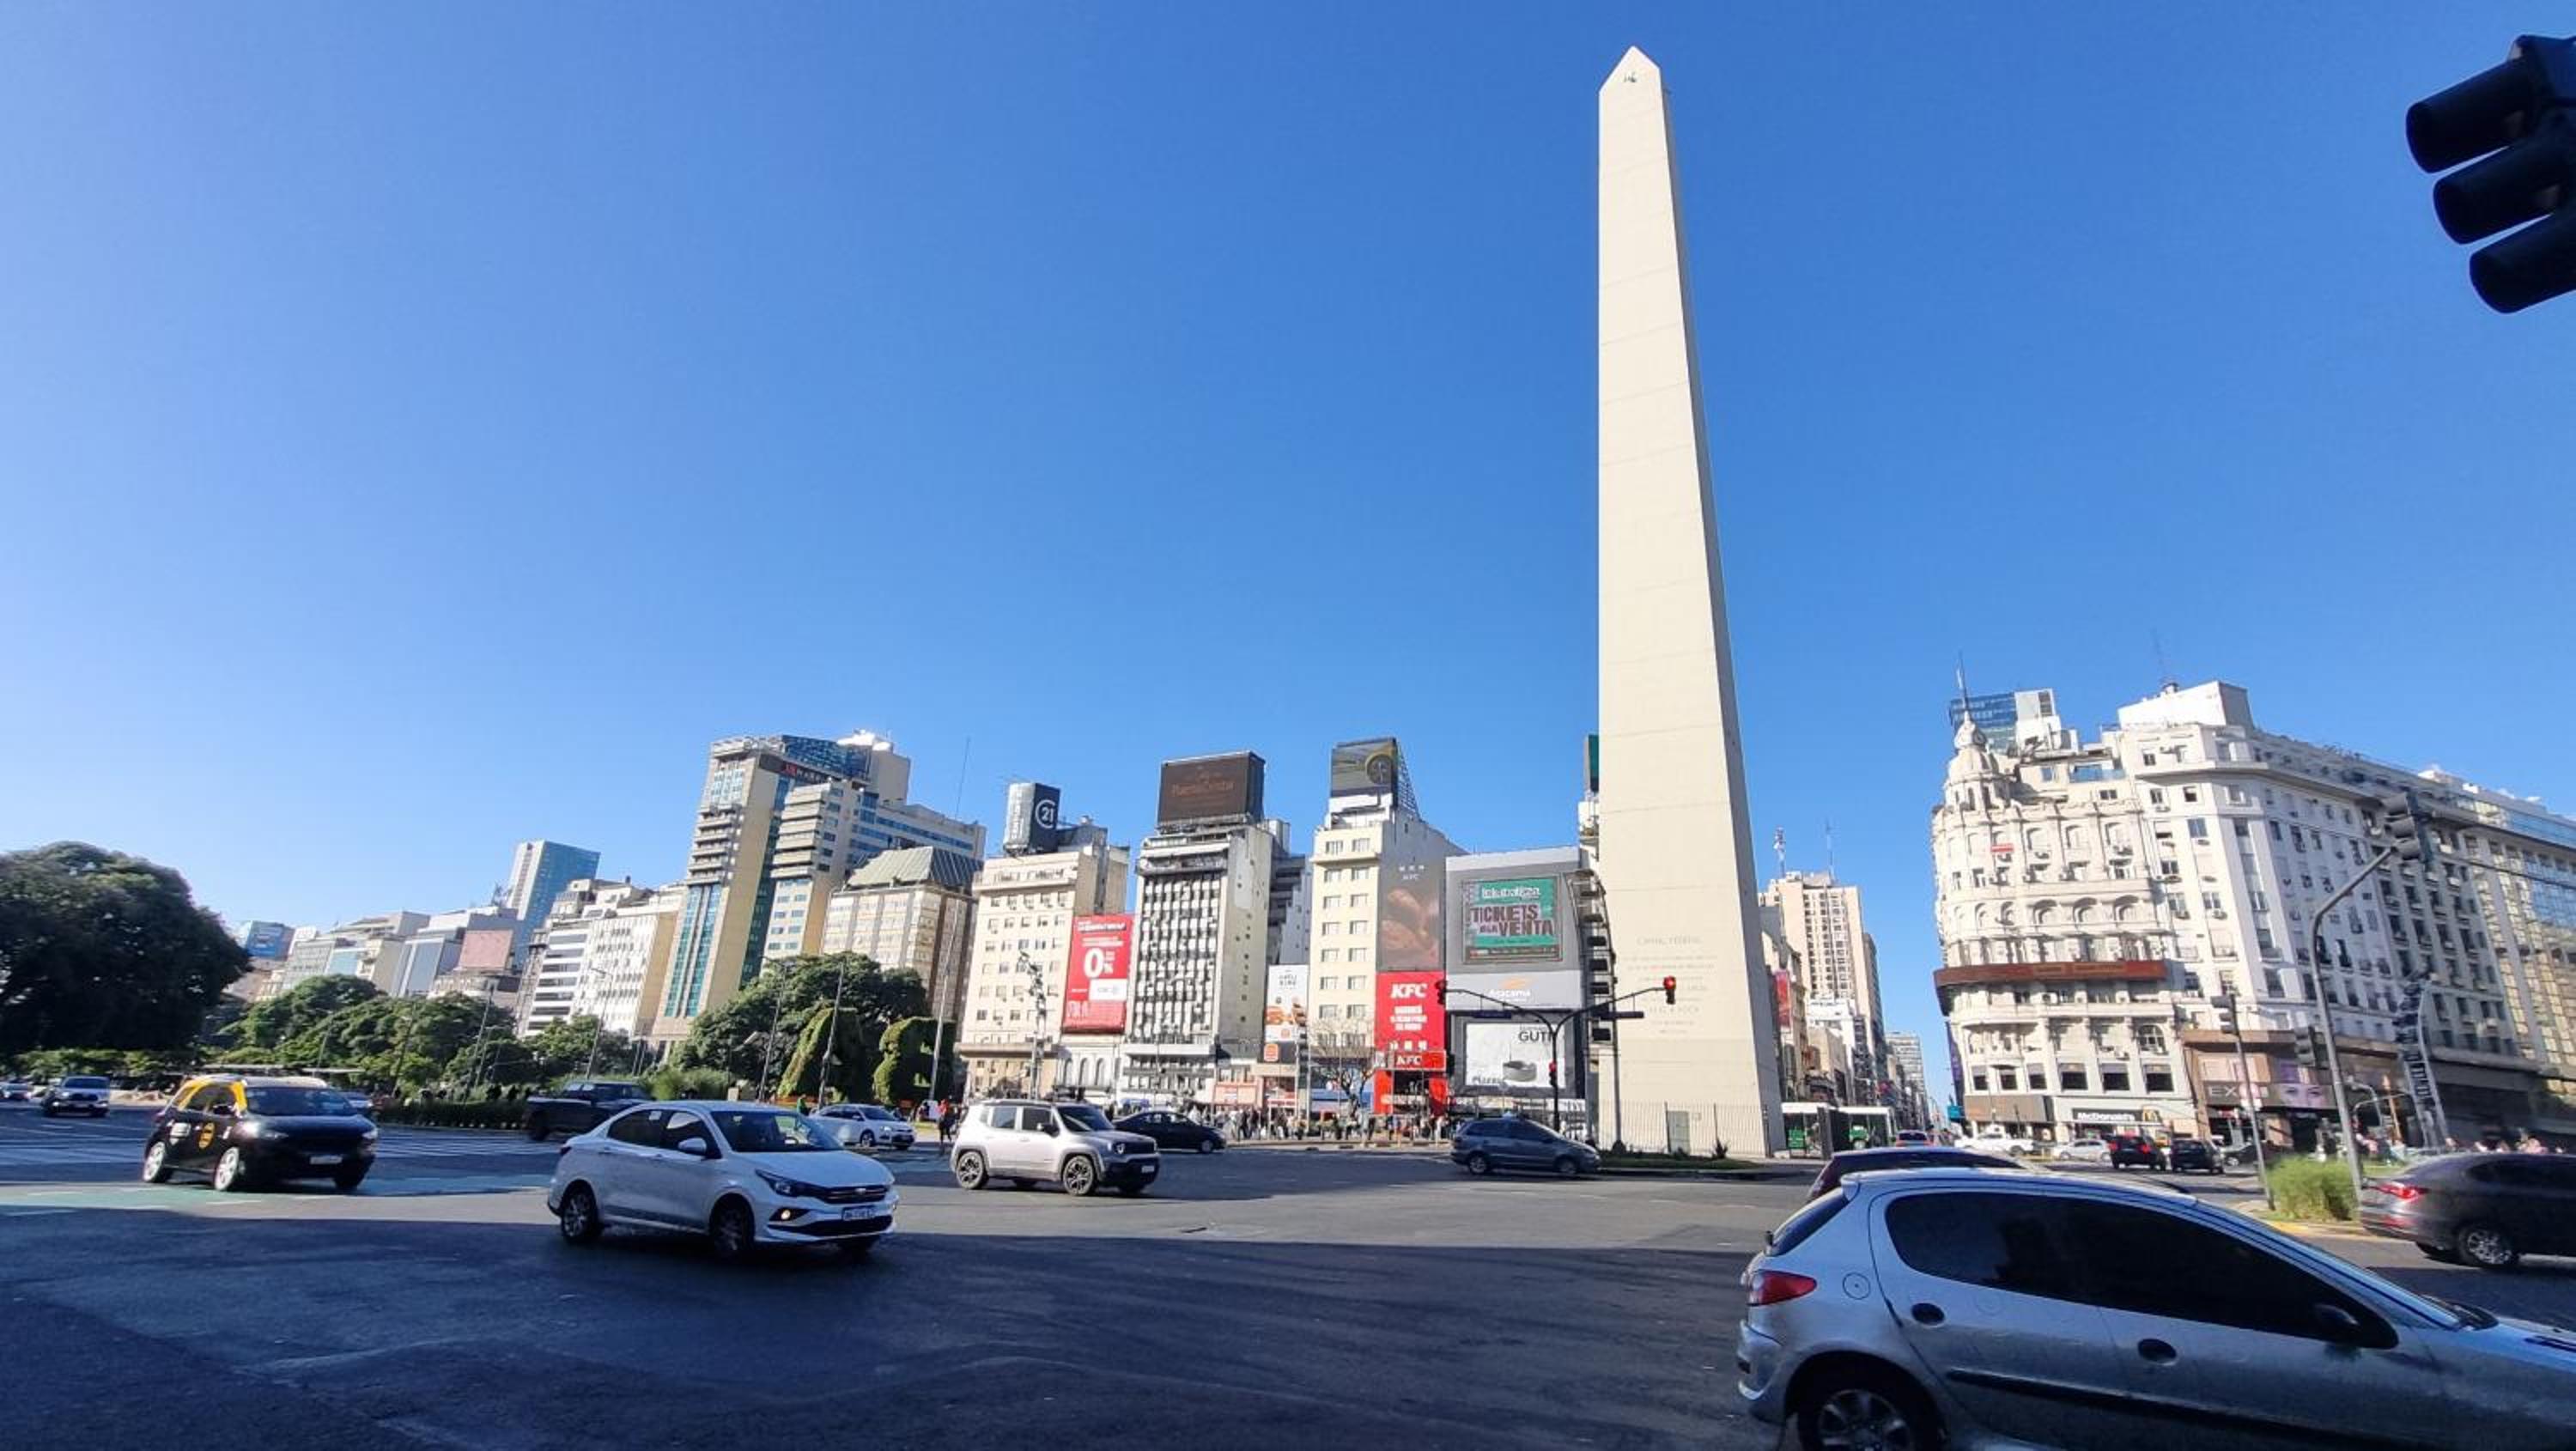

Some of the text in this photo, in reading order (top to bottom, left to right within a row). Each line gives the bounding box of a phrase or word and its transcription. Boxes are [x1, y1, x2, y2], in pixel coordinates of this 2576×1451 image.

[1471, 904, 1539, 924] TICKETS
[1499, 920, 1553, 936] VENTA
[1390, 983, 1428, 999] KFC
[1396, 1055, 1422, 1065] KFC
